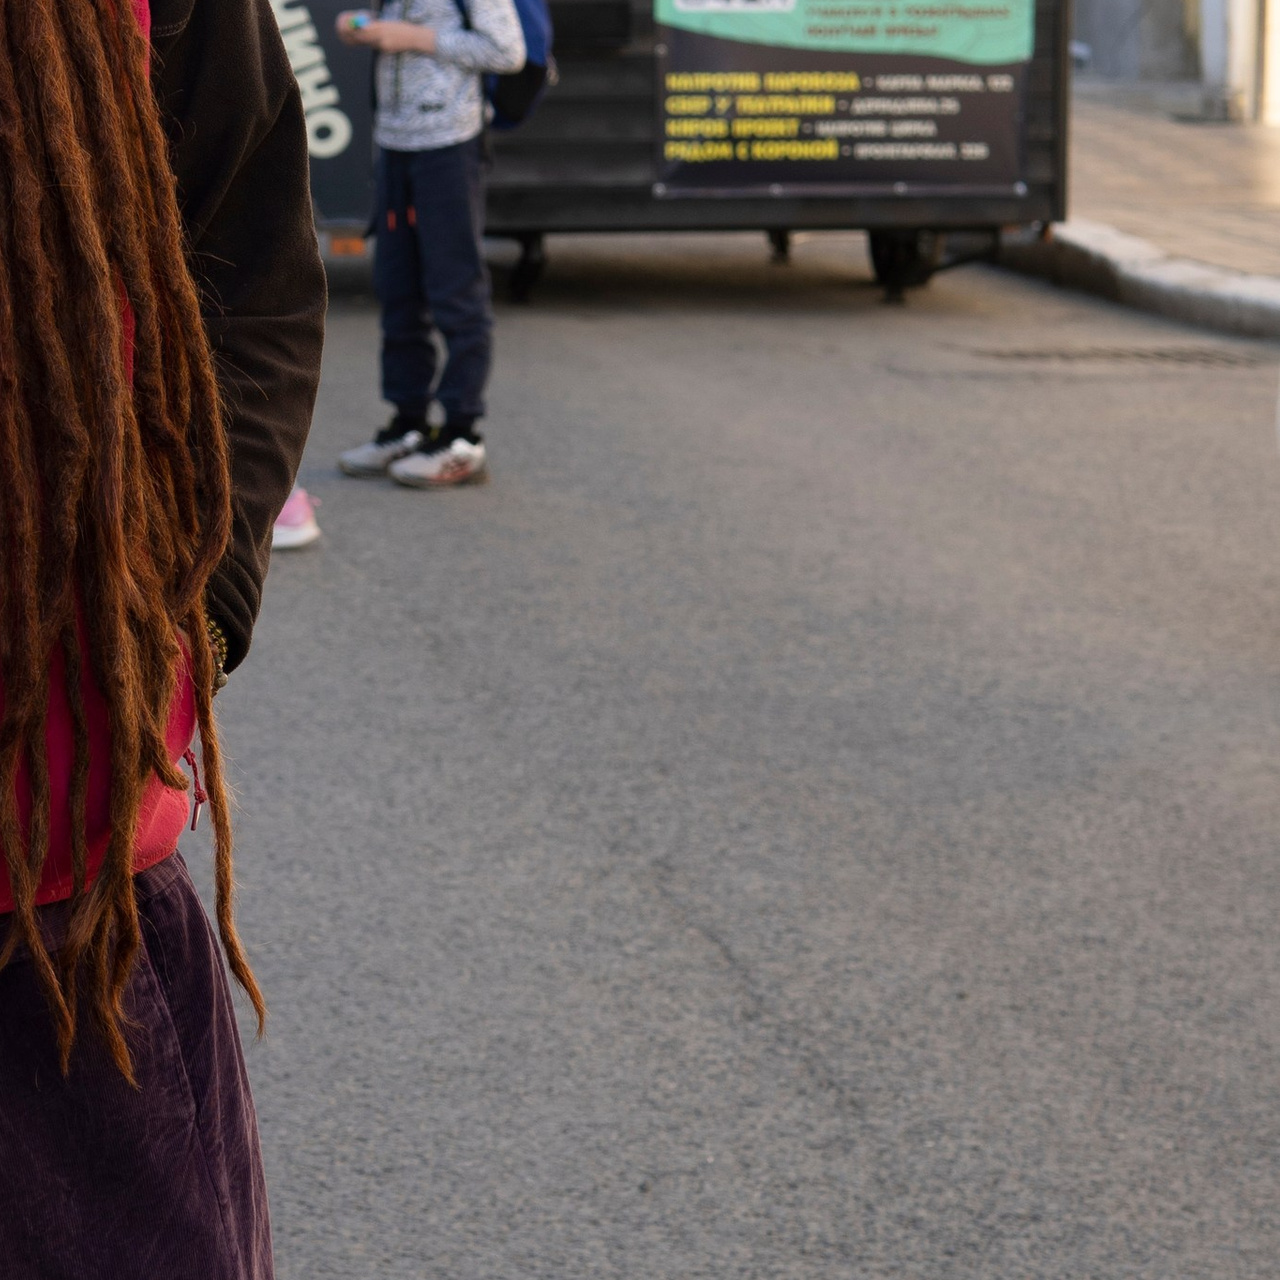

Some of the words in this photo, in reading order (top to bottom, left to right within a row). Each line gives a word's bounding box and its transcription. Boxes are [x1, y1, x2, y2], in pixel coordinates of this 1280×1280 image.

[665, 71, 761, 92] НАПРОТИВ
[764, 71, 861, 93] ПАРОВОЗА
[664, 140, 734, 162] РЯДОМ
[751, 136, 840, 160] КОРОНОЙ
